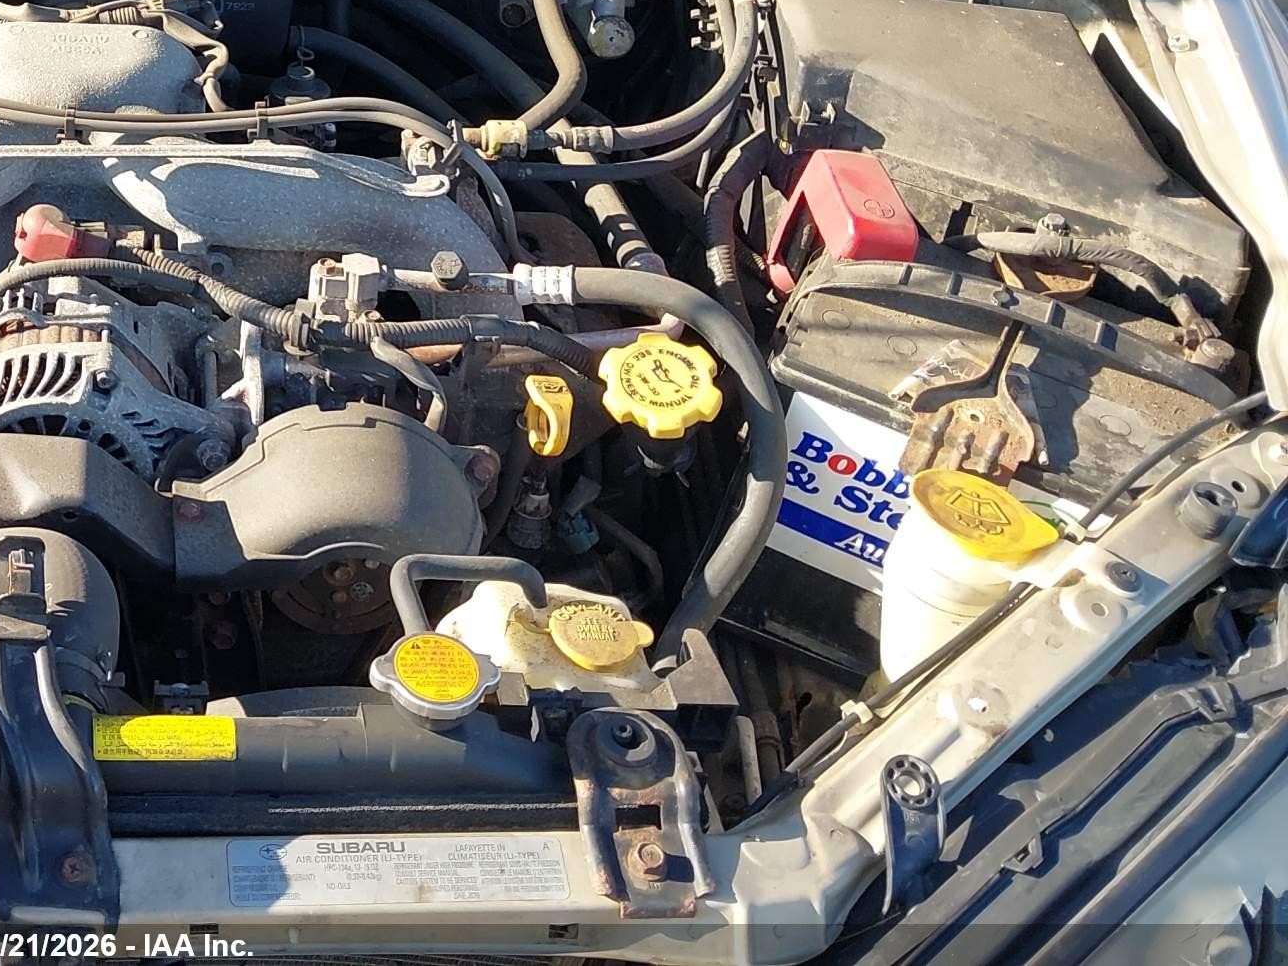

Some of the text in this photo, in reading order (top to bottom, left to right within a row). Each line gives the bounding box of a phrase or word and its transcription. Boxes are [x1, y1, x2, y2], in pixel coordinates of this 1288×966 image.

[658, 348, 701, 389] ENGINE OIL
[648, 394, 693, 408] MANUAL
[785, 460, 820, 495] &
[578, 632, 618, 642] MANUAL
[316, 841, 406, 854] SUBARU
[455, 843, 496, 852] LAFAYETTE
[542, 842, 550, 851] A
[295, 855, 313, 864] AIR
[314, 854, 379, 863] CONDITIONER
[448, 852, 503, 861] CLIMATISEUR
